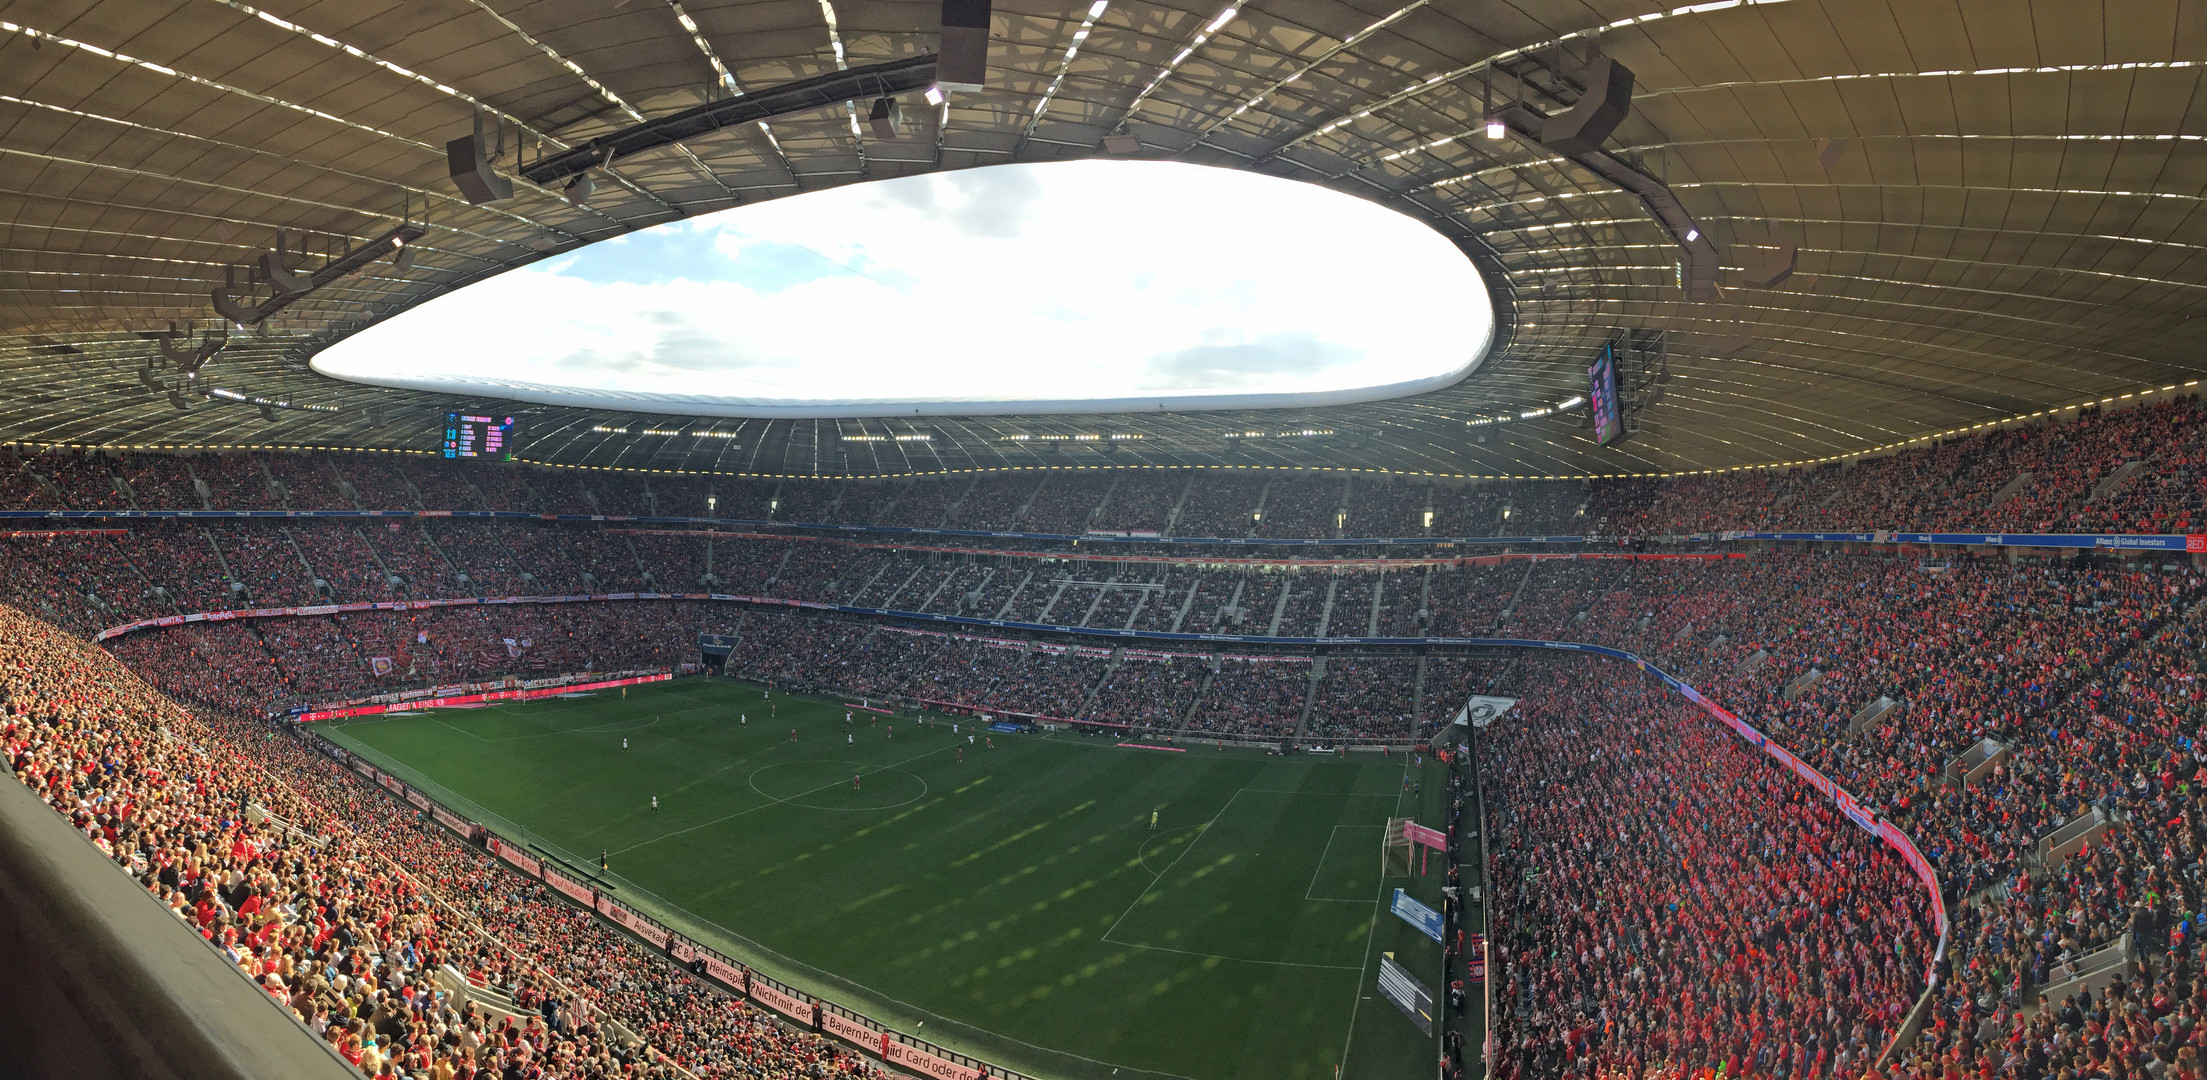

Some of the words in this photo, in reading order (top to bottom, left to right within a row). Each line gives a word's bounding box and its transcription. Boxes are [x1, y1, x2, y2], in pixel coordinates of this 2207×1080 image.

[2121, 538, 2138, 546] Global
[2139, 538, 2166, 546] Investors
[2187, 539, 2204, 550] RED
[418, 699, 434, 708] EINS
[673, 942, 683, 955] FC
[755, 984, 777, 1004] Nicht
[776, 999, 793, 1012] mit
[795, 1004, 812, 1019] der
[829, 1016, 862, 1039] Bayern
[905, 1050, 931, 1069] Card
[931, 1062, 957, 1079] oder
